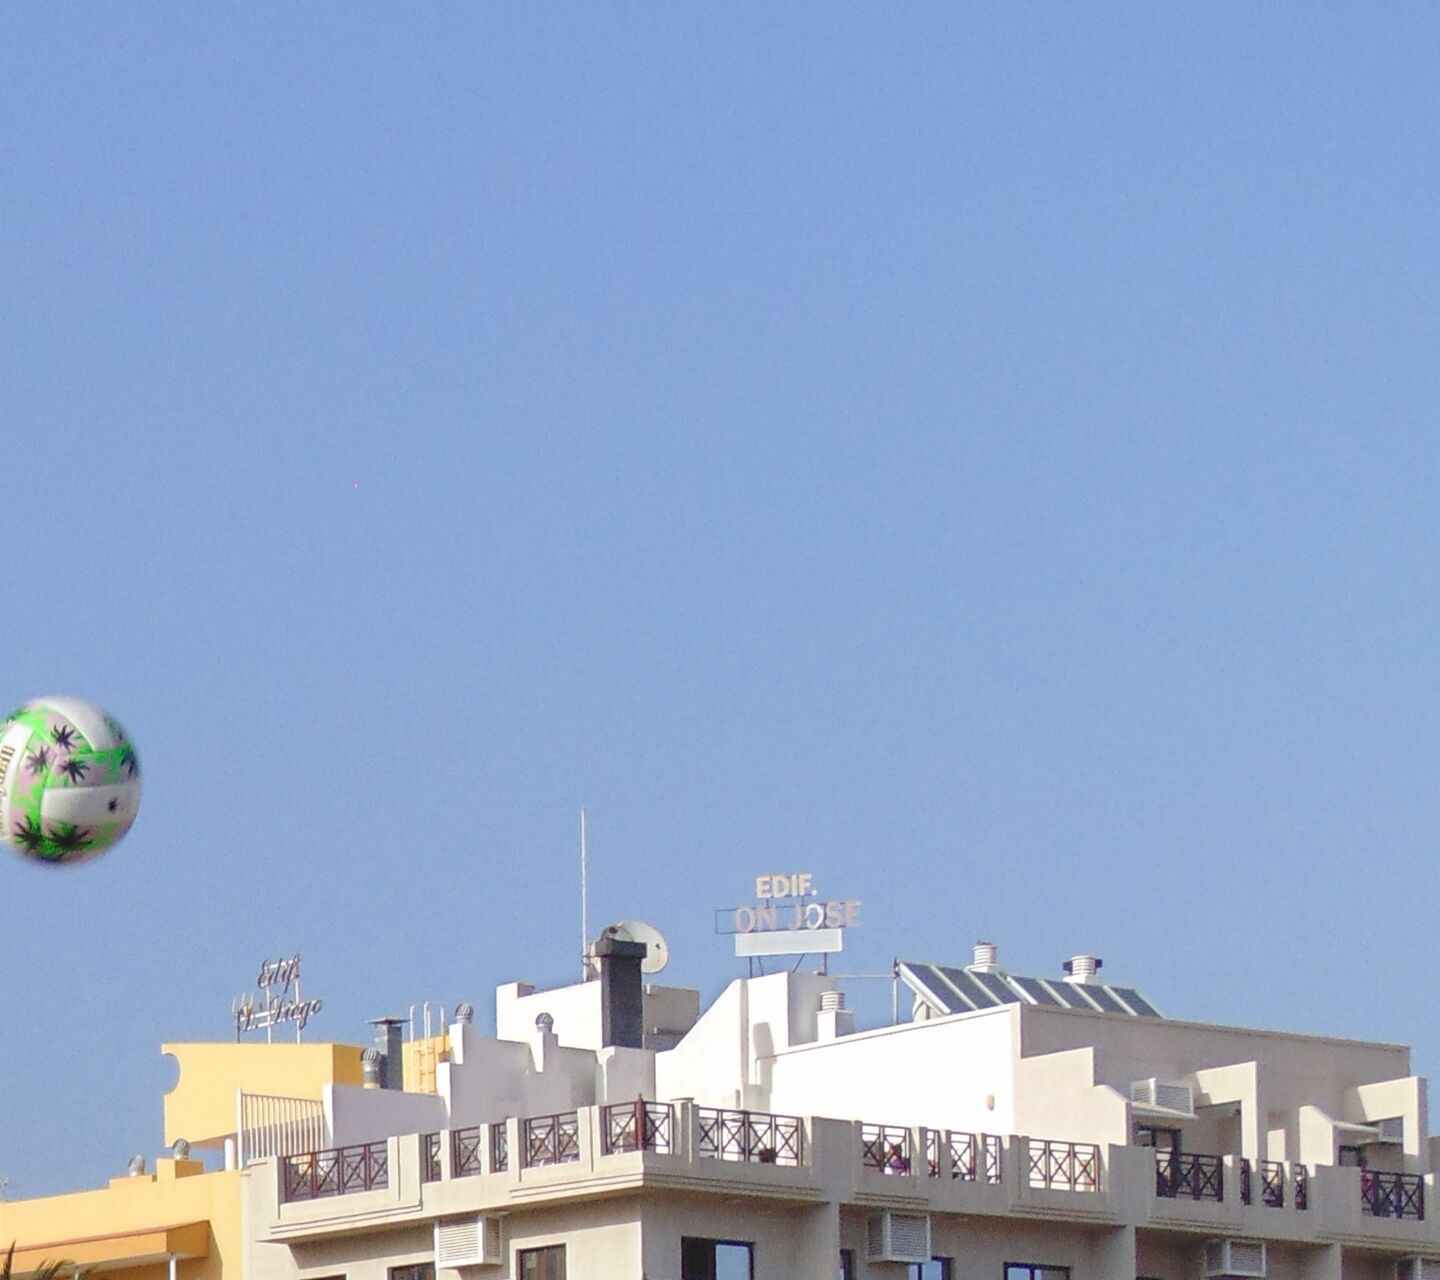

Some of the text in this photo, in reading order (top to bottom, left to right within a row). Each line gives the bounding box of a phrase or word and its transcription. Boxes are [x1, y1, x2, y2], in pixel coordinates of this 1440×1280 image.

[756, 873, 818, 898] EDIF.
[735, 900, 863, 933] ON JOSE
